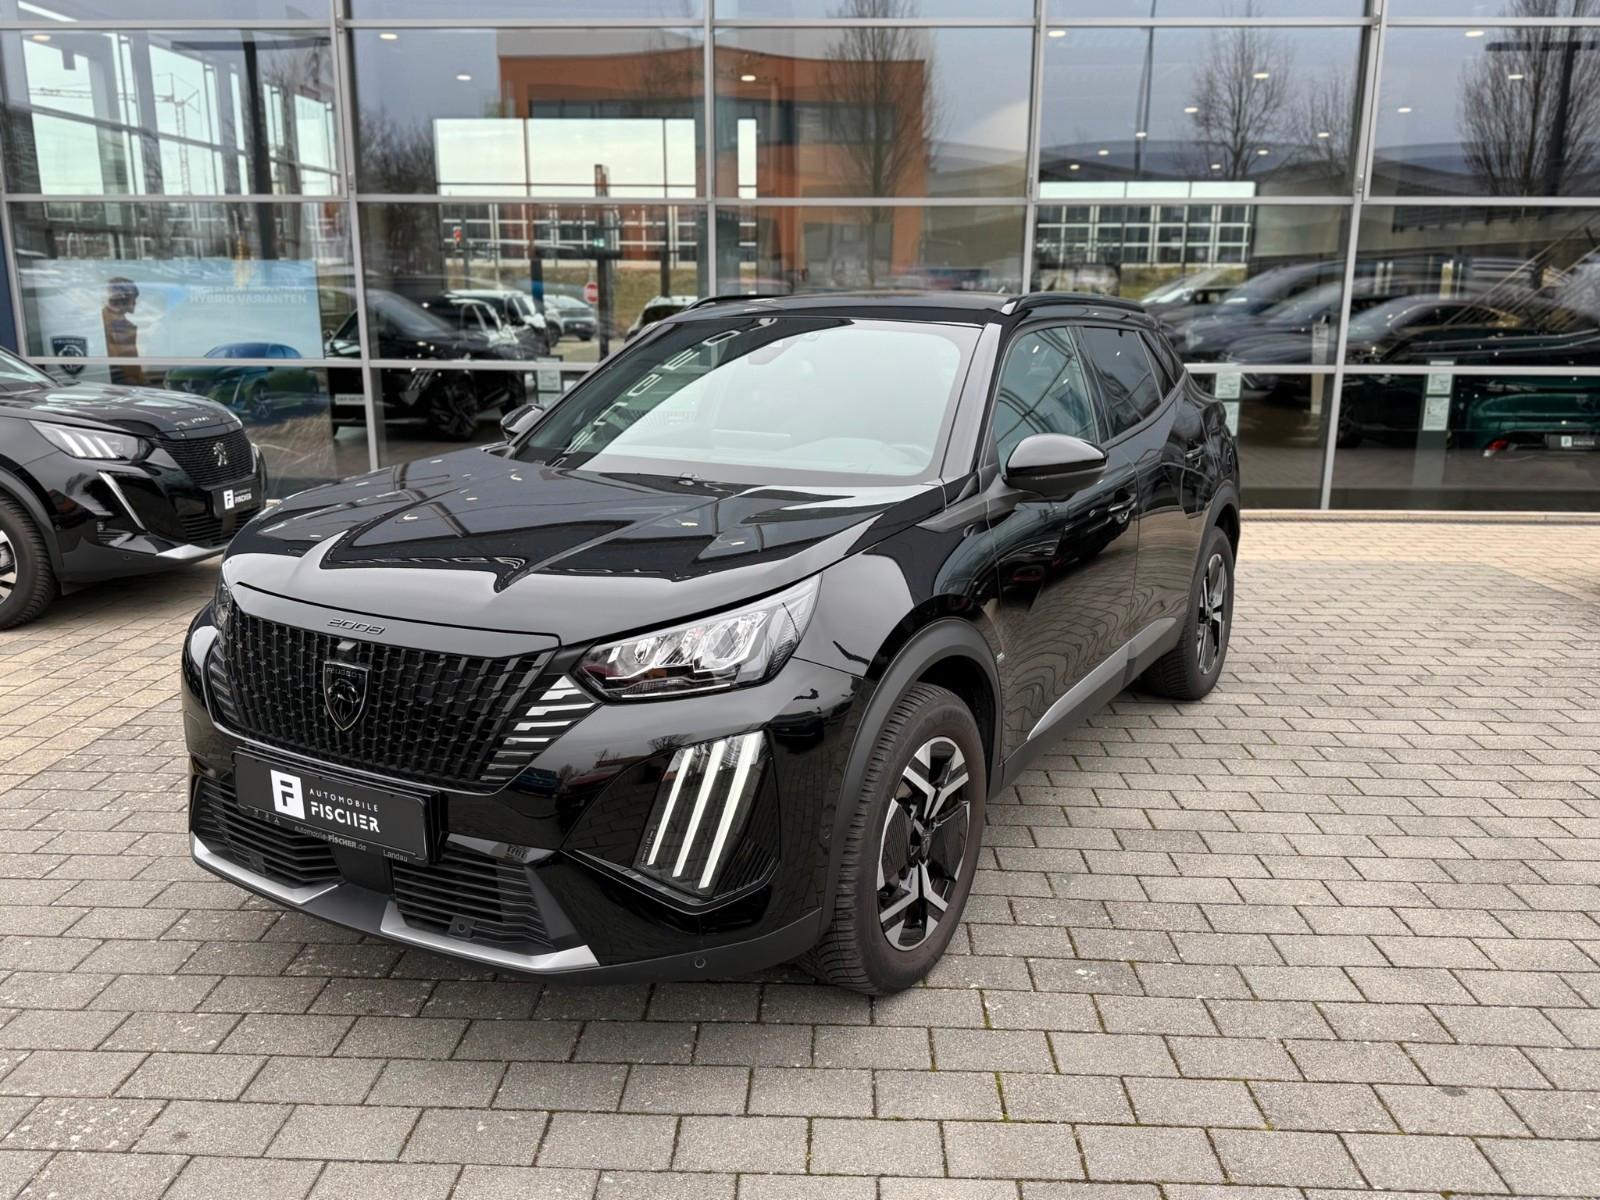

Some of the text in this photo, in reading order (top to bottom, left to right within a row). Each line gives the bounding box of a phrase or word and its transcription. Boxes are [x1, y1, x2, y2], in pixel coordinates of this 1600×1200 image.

[327, 618, 386, 635] 2008
[309, 788, 379, 812] AUTOMOBILE
[310, 801, 381, 833] FISCHER
[383, 849, 408, 862] Landau
